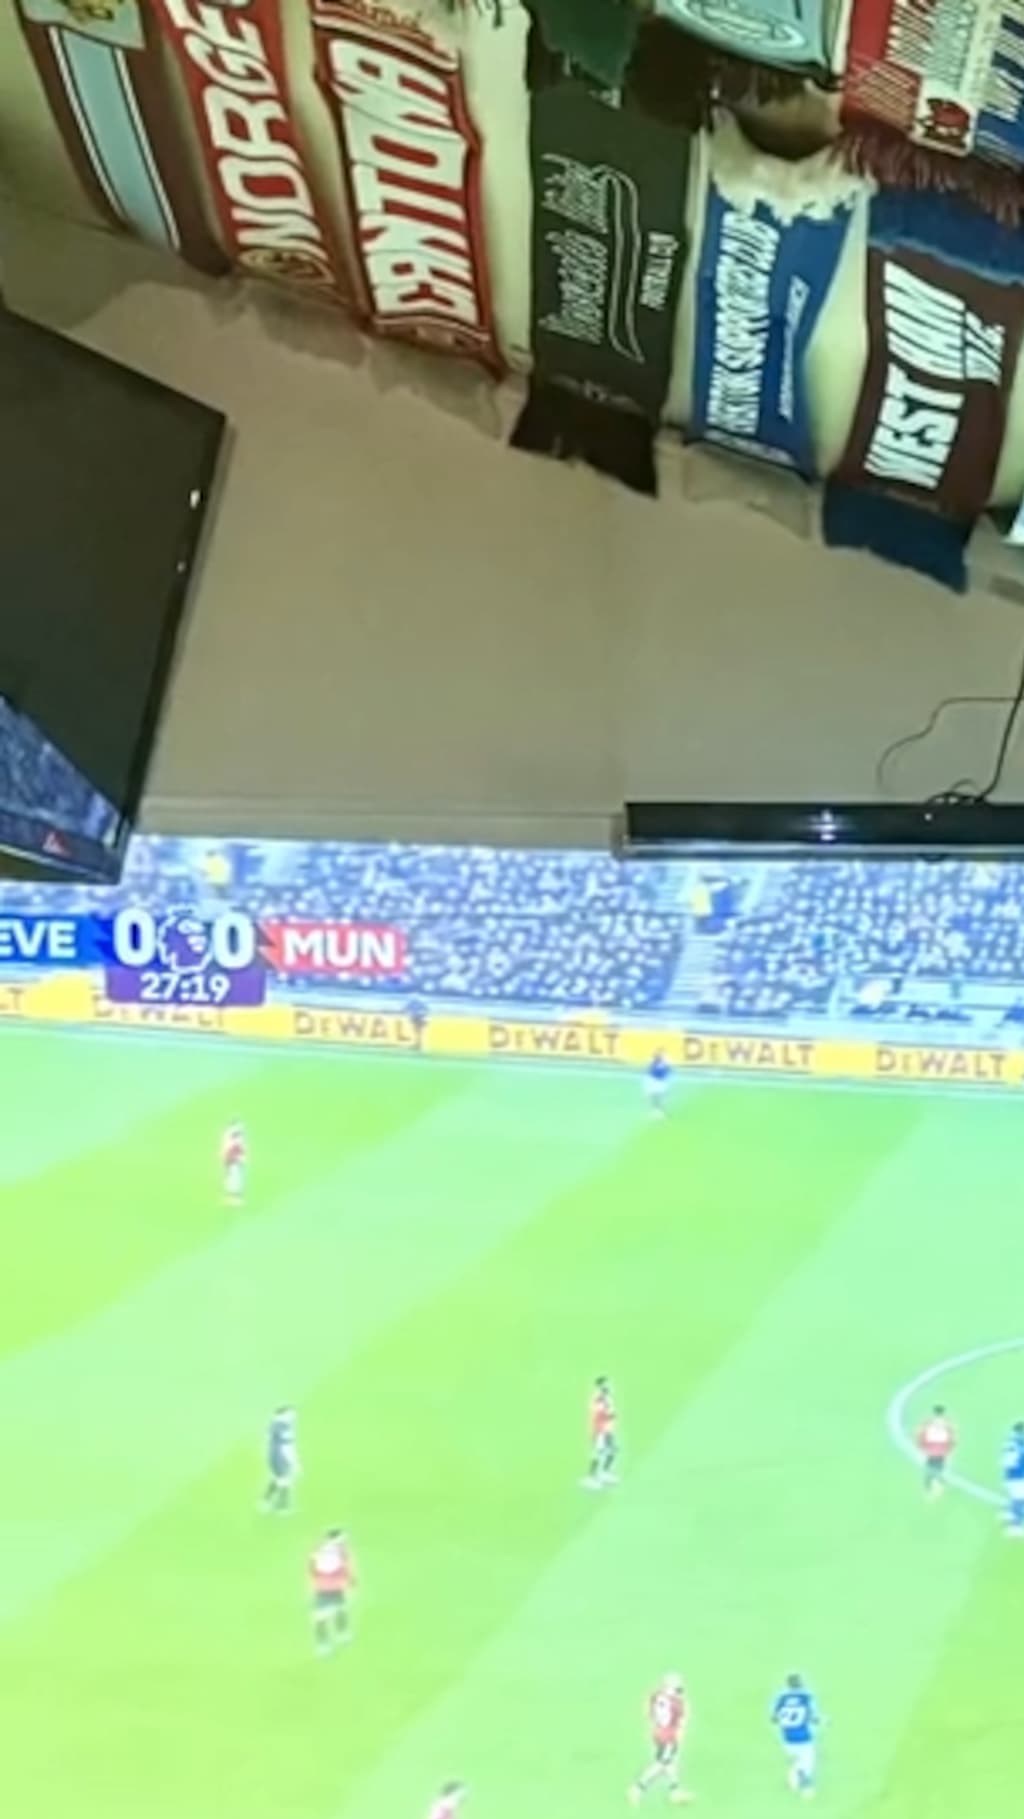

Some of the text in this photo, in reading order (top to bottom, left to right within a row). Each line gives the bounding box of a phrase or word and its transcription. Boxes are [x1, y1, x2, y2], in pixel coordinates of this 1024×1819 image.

[329, 38, 480, 324] CANTONA
[863, 260, 967, 490] WEST HAM
[0, 908, 397, 969] EVE 0 0 MUN
[140, 972, 231, 1002] 27:19
